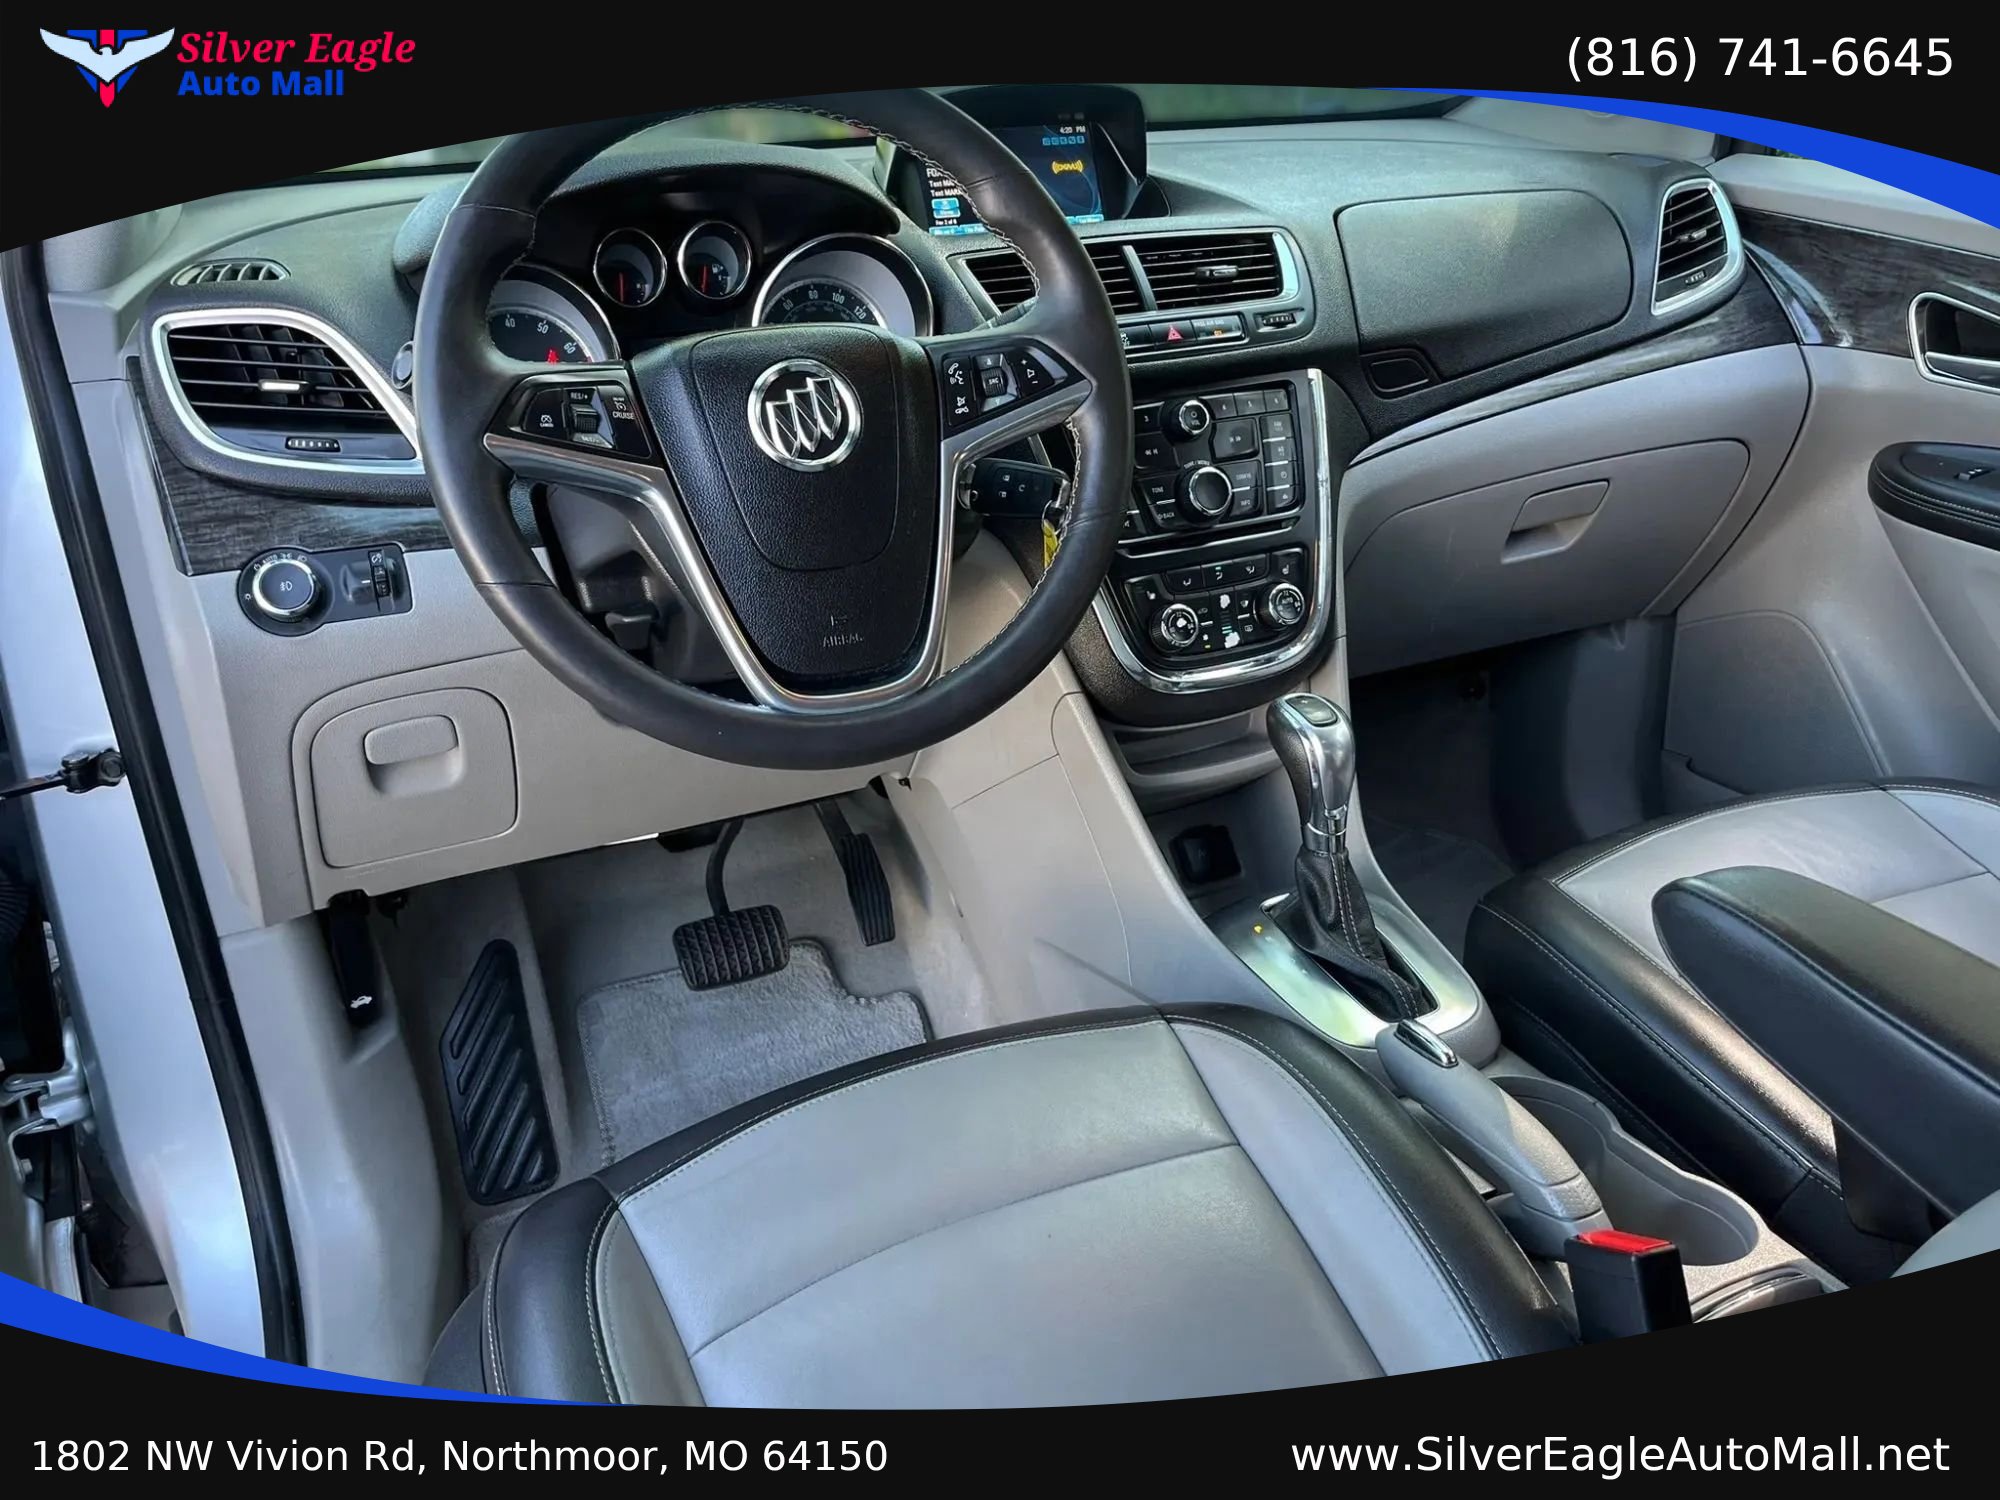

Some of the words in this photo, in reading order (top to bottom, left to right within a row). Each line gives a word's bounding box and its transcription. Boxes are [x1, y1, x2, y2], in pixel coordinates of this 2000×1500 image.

[832, 292, 846, 305] 100
[853, 305, 867, 320] 120
[505, 318, 516, 328] 40
[536, 322, 549, 334] 50
[563, 342, 576, 354] 60
[612, 411, 635, 420] CRUISE
